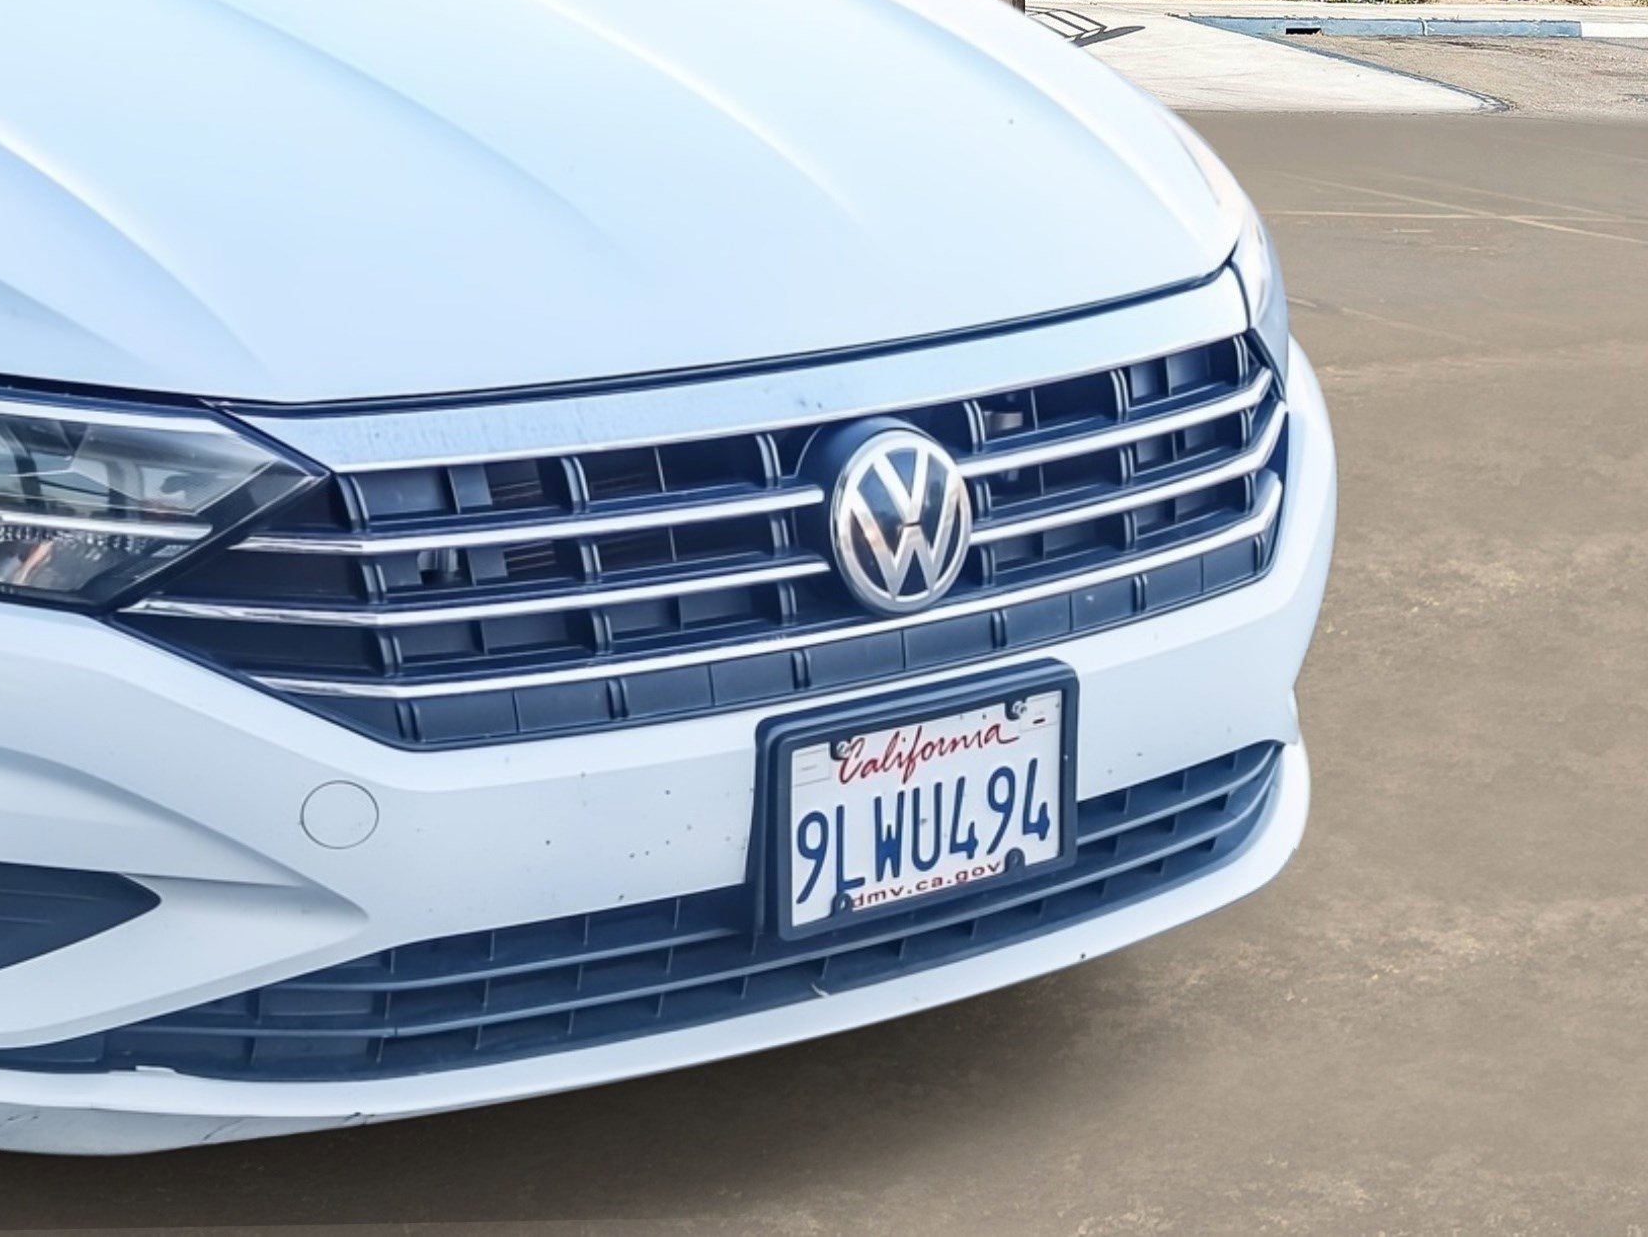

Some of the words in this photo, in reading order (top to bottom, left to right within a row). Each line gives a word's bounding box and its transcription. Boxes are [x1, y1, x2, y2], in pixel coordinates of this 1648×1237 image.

[839, 724, 1019, 785] California
[795, 757, 1051, 905] 9LWU494
[852, 860, 1002, 908] dmv.ca.gov
